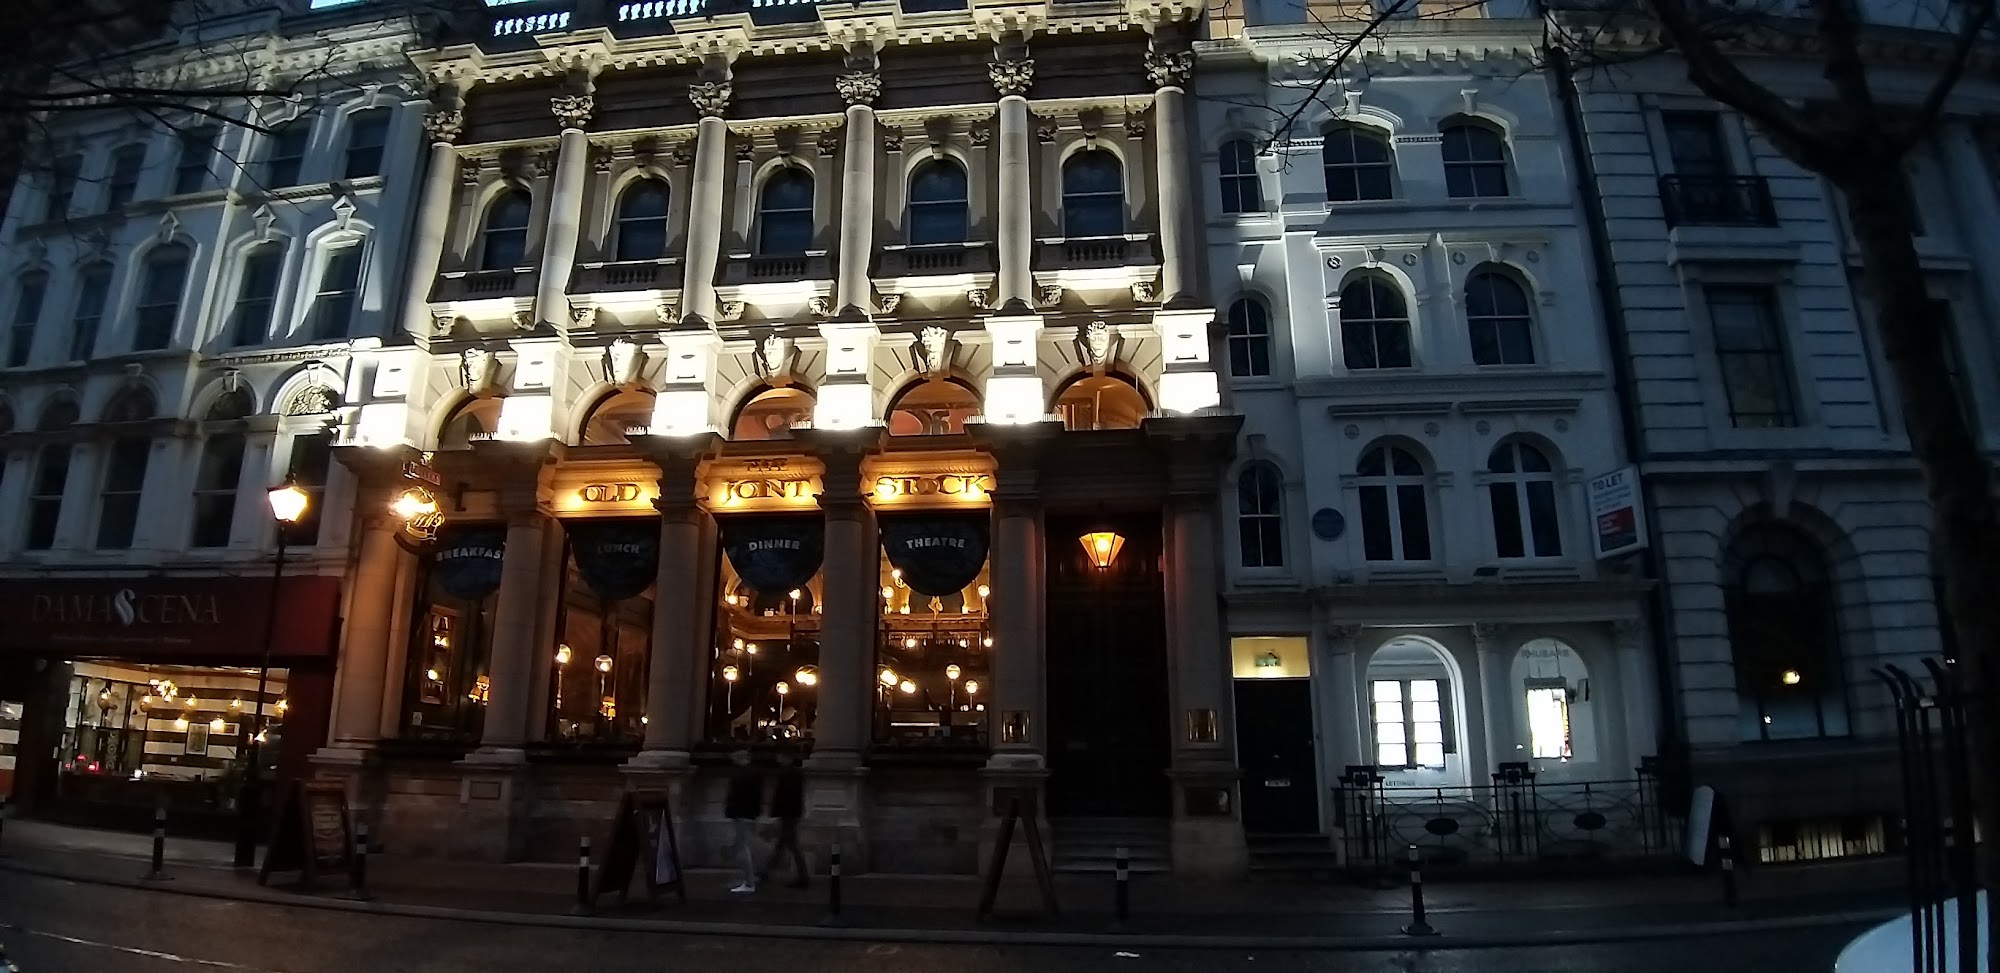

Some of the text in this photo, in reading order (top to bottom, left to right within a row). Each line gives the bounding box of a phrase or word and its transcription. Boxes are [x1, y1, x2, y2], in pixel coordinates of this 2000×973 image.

[578, 474, 990, 504] OLD JOINT STOCK
[1592, 473, 1623, 491] TO LET
[597, 543, 640, 554] LUNCH
[748, 538, 800, 552] DINNER
[905, 536, 966, 550] THEATRE
[435, 545, 505, 562] BREAKFAS
[31, 588, 222, 627] DAMASCENA
